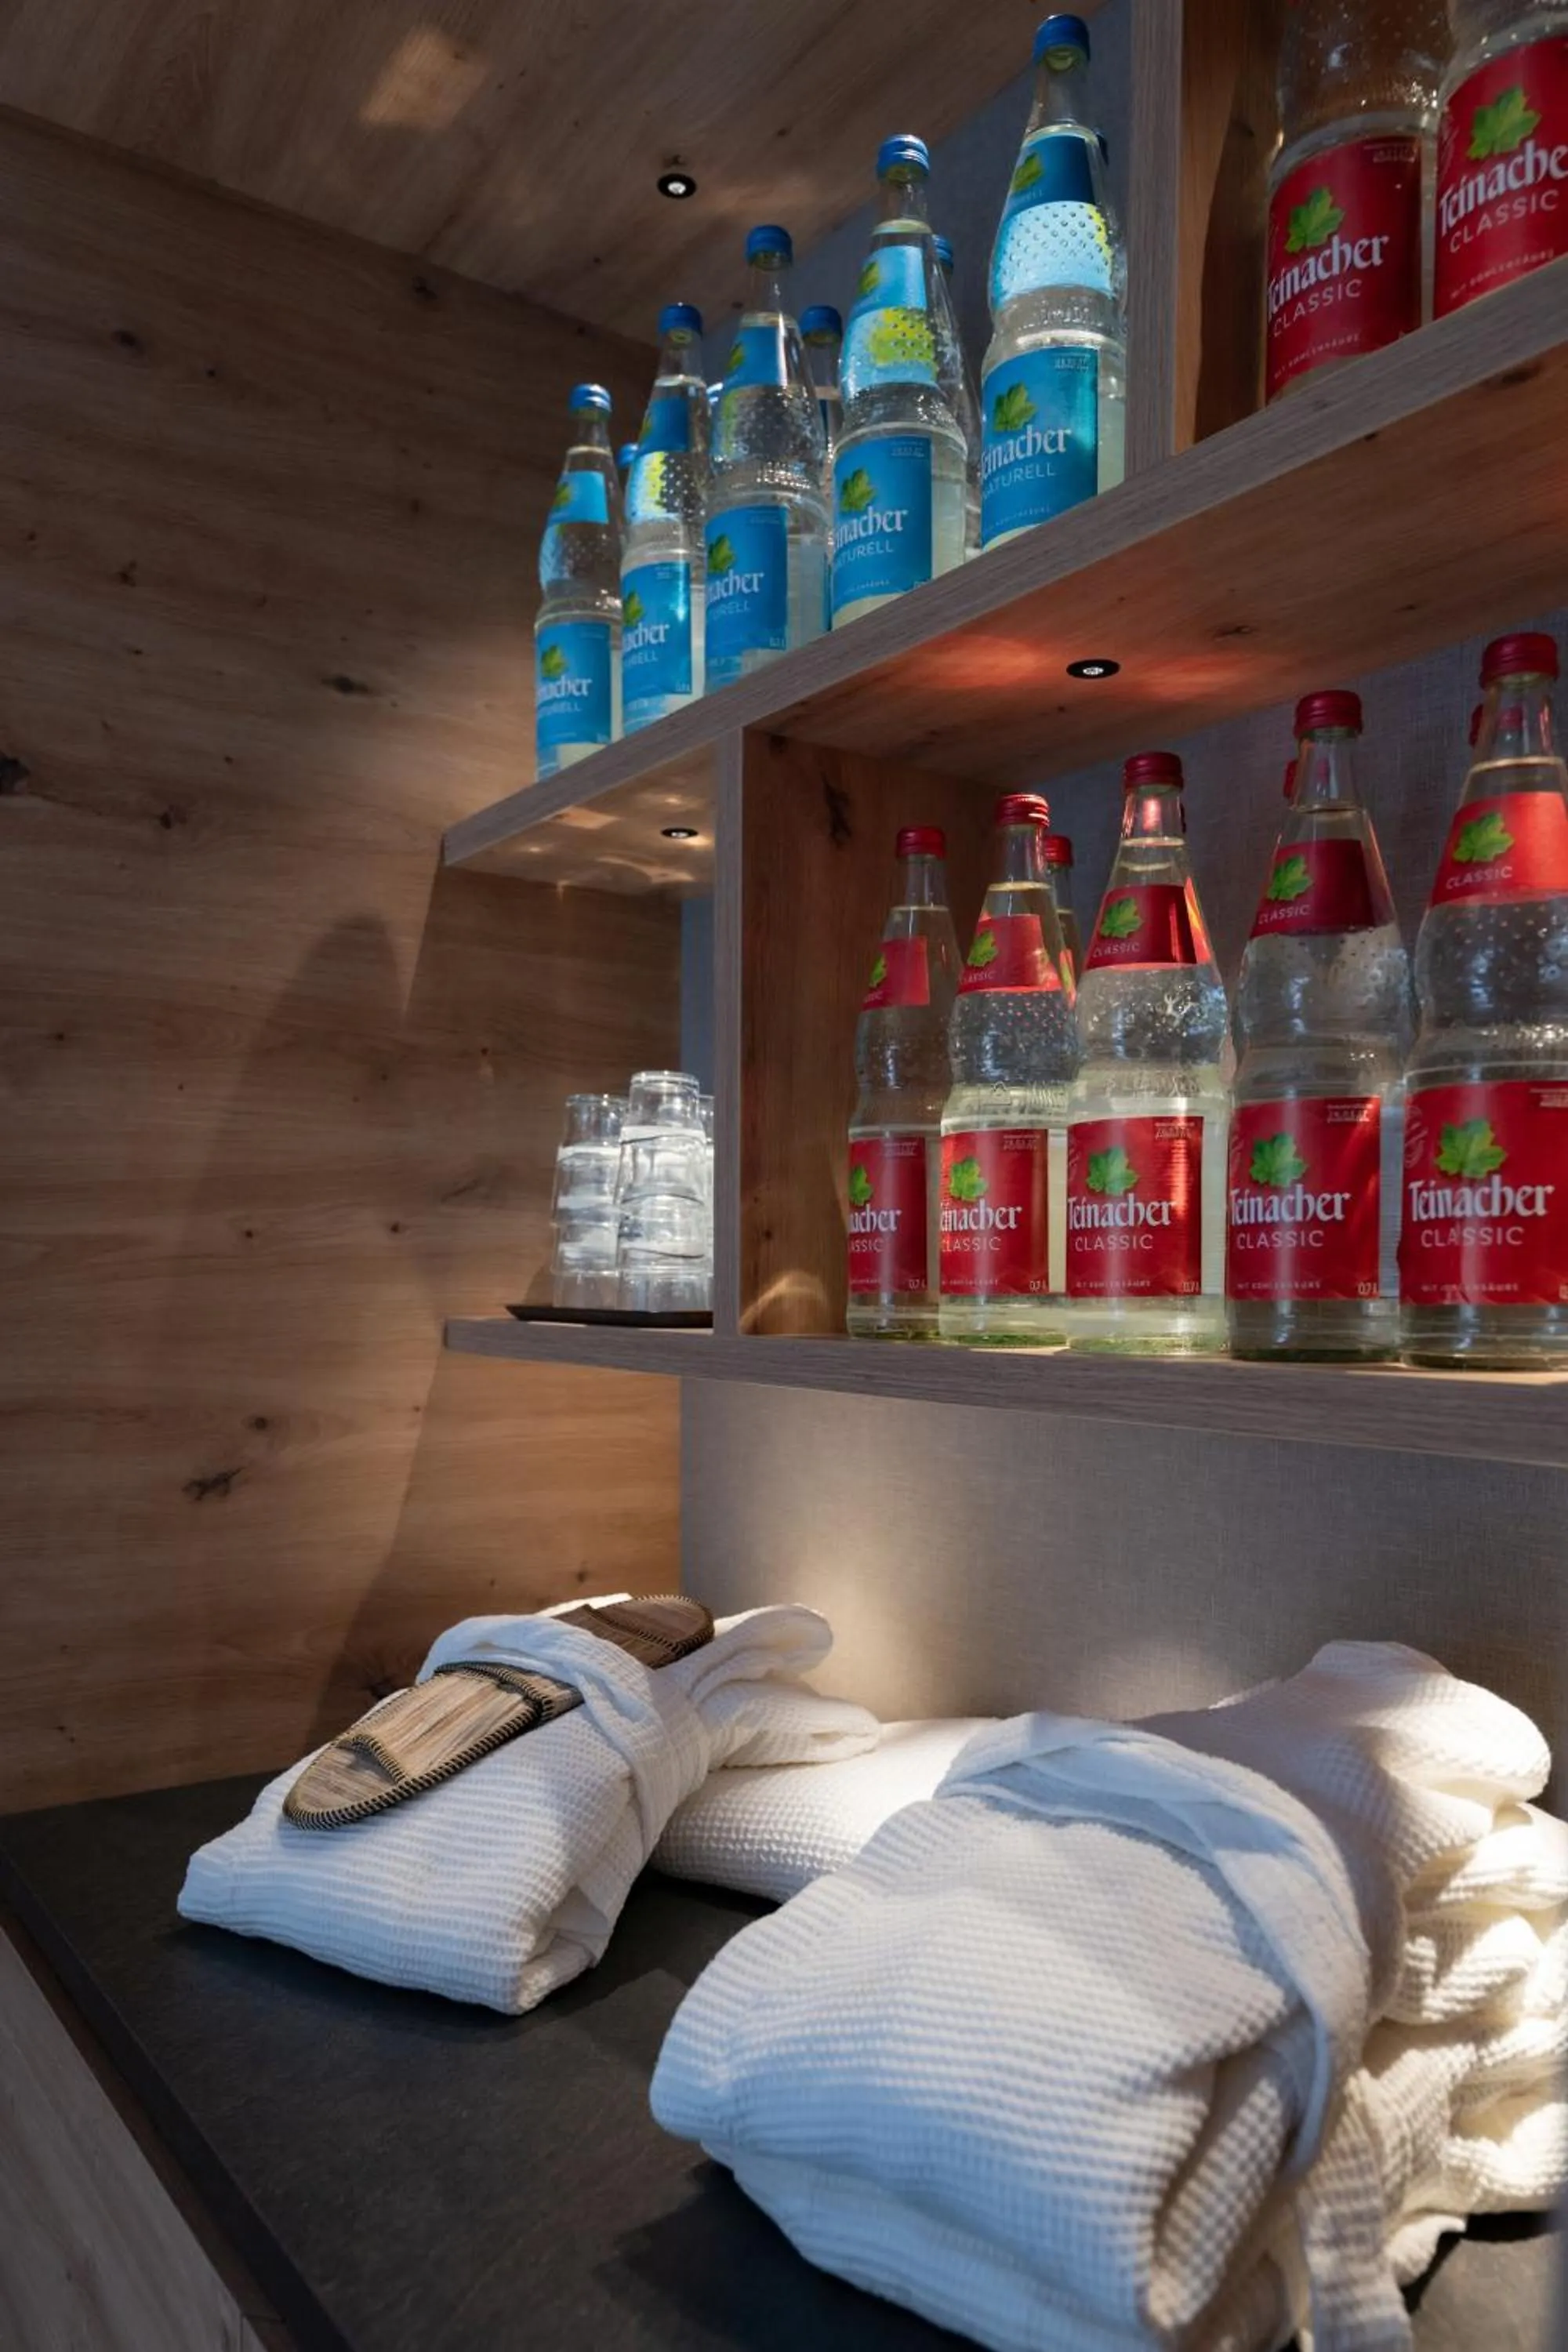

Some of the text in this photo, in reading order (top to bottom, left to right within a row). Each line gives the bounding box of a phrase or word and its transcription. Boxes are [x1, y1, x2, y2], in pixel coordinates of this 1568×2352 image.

[1439, 140, 1568, 238] Teinache
[1450, 188, 1559, 254] CLASSIC
[1272, 278, 1363, 338] CLASSIC
[1067, 1192, 1176, 1230] Teinacher
[1229, 1183, 1352, 1226] Teinacher
[1408, 1174, 1555, 1223] Teinacher
[1075, 1233, 1154, 1252] CLASSIC
[1236, 1229, 1325, 1250] CLASSIC
[1421, 1225, 1525, 1249] CLASSIC
